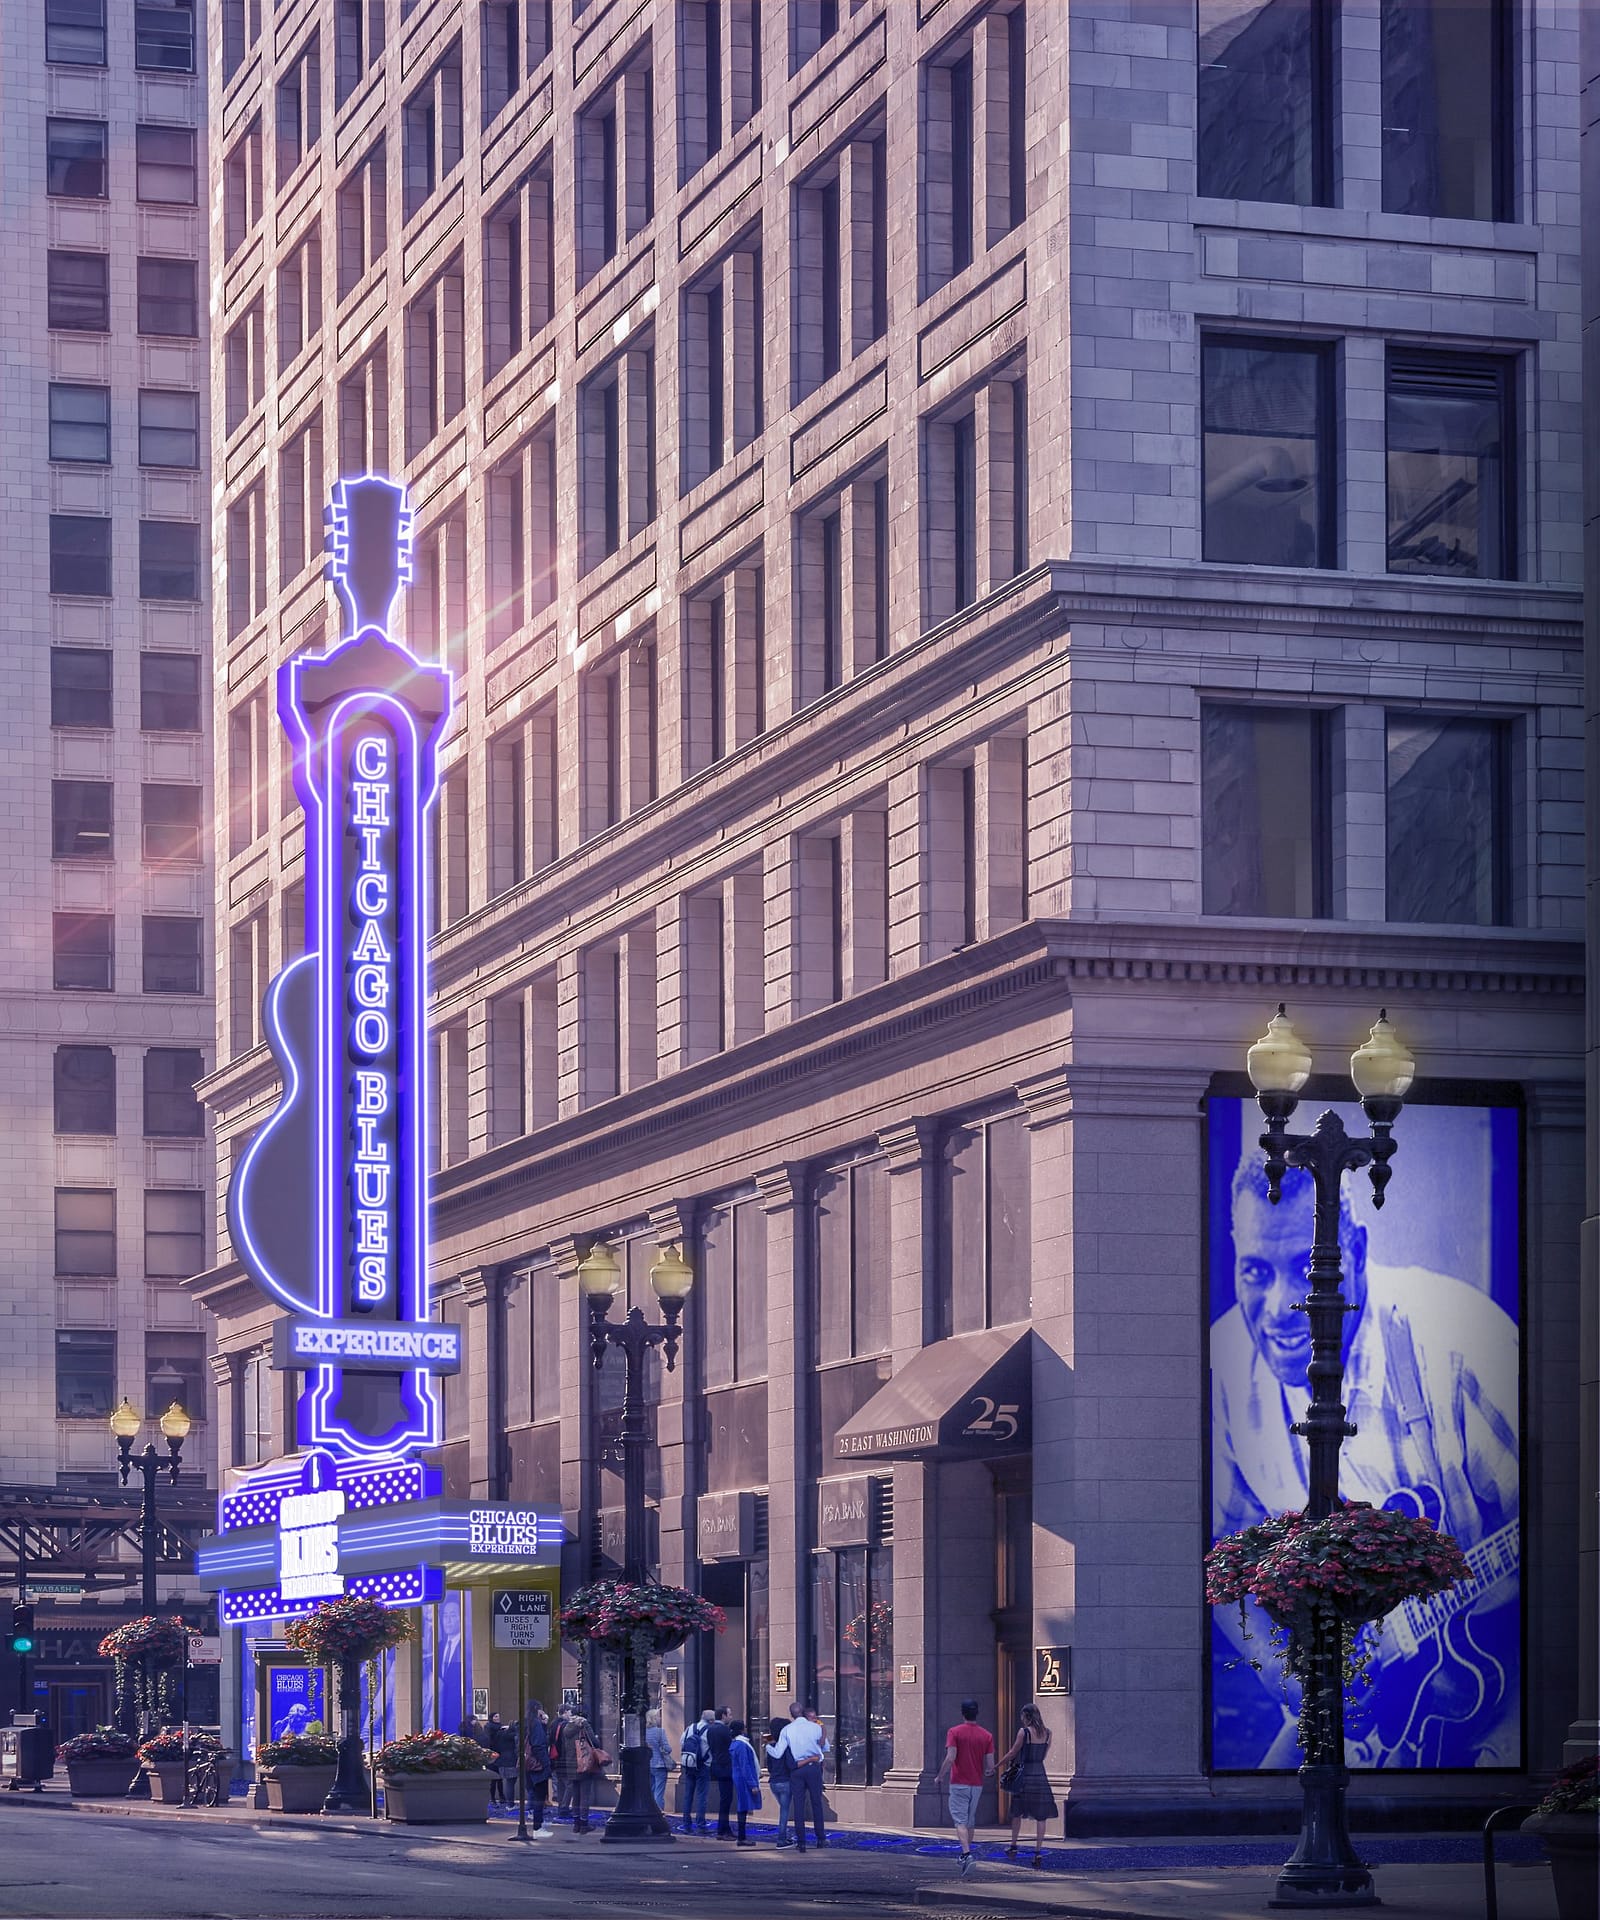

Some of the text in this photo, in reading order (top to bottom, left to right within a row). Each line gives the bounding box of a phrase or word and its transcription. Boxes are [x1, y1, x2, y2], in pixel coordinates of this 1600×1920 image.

[352, 737, 391, 1301] CHICAGO BLUES
[294, 1326, 458, 1360] EXPERIENCE
[966, 1396, 1019, 1441] 25
[839, 1425, 933, 1453] 25 EAST WASHINGTON
[469, 1510, 538, 1526] CHICAGO
[469, 1524, 538, 1546] BLUES
[470, 1543, 537, 1555] EXPERIENCE
[35, 1585, 72, 1593] WABASH
[518, 1594, 548, 1602] RIGHT
[520, 1604, 547, 1612] LANE
[503, 1615, 541, 1624] BUSES &
[510, 1623, 533, 1631] RIGHT
[510, 1631, 535, 1639] TURNS
[512, 1638, 533, 1646] ONLY
[1042, 1654, 1061, 1691] 25
[276, 1680, 304, 1689] BLUES
